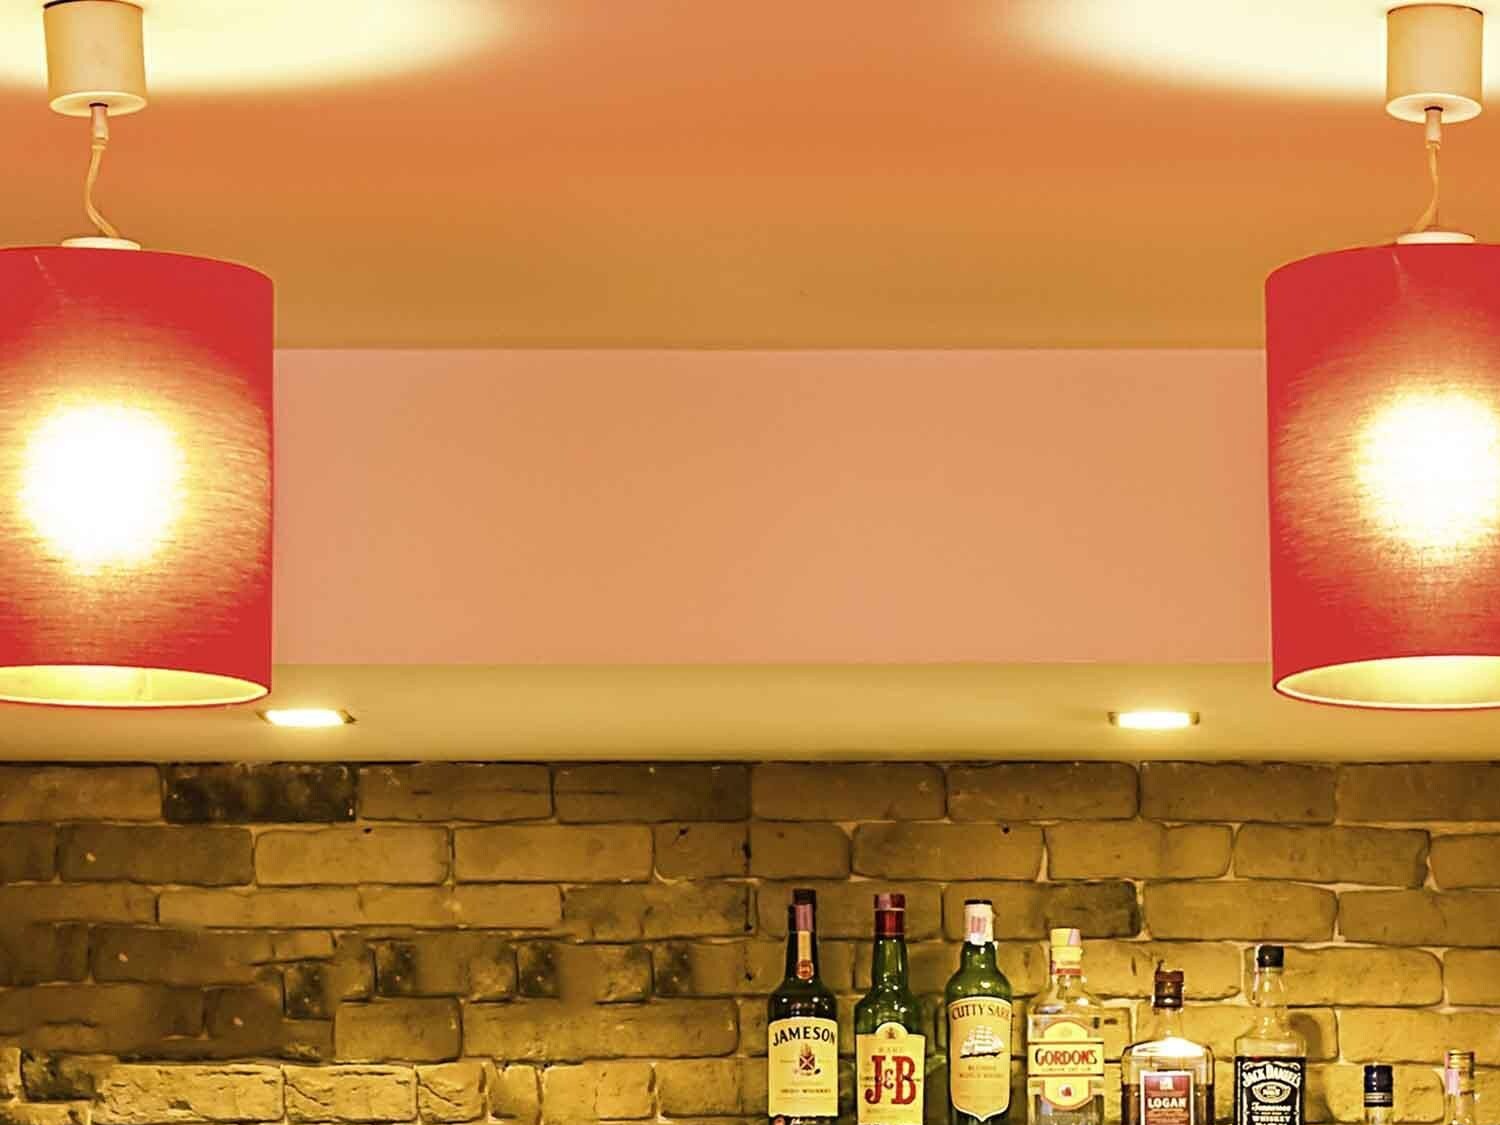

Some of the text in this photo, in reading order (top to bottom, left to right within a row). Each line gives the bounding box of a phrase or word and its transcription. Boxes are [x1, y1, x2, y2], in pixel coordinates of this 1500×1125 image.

[952, 1004, 985, 1020] CUTTY
[773, 1026, 836, 1046] JAMESON
[864, 1055, 917, 1105] J&B
[1241, 1067, 1267, 1088] JACK
[1147, 1097, 1188, 1109] LOGAN
